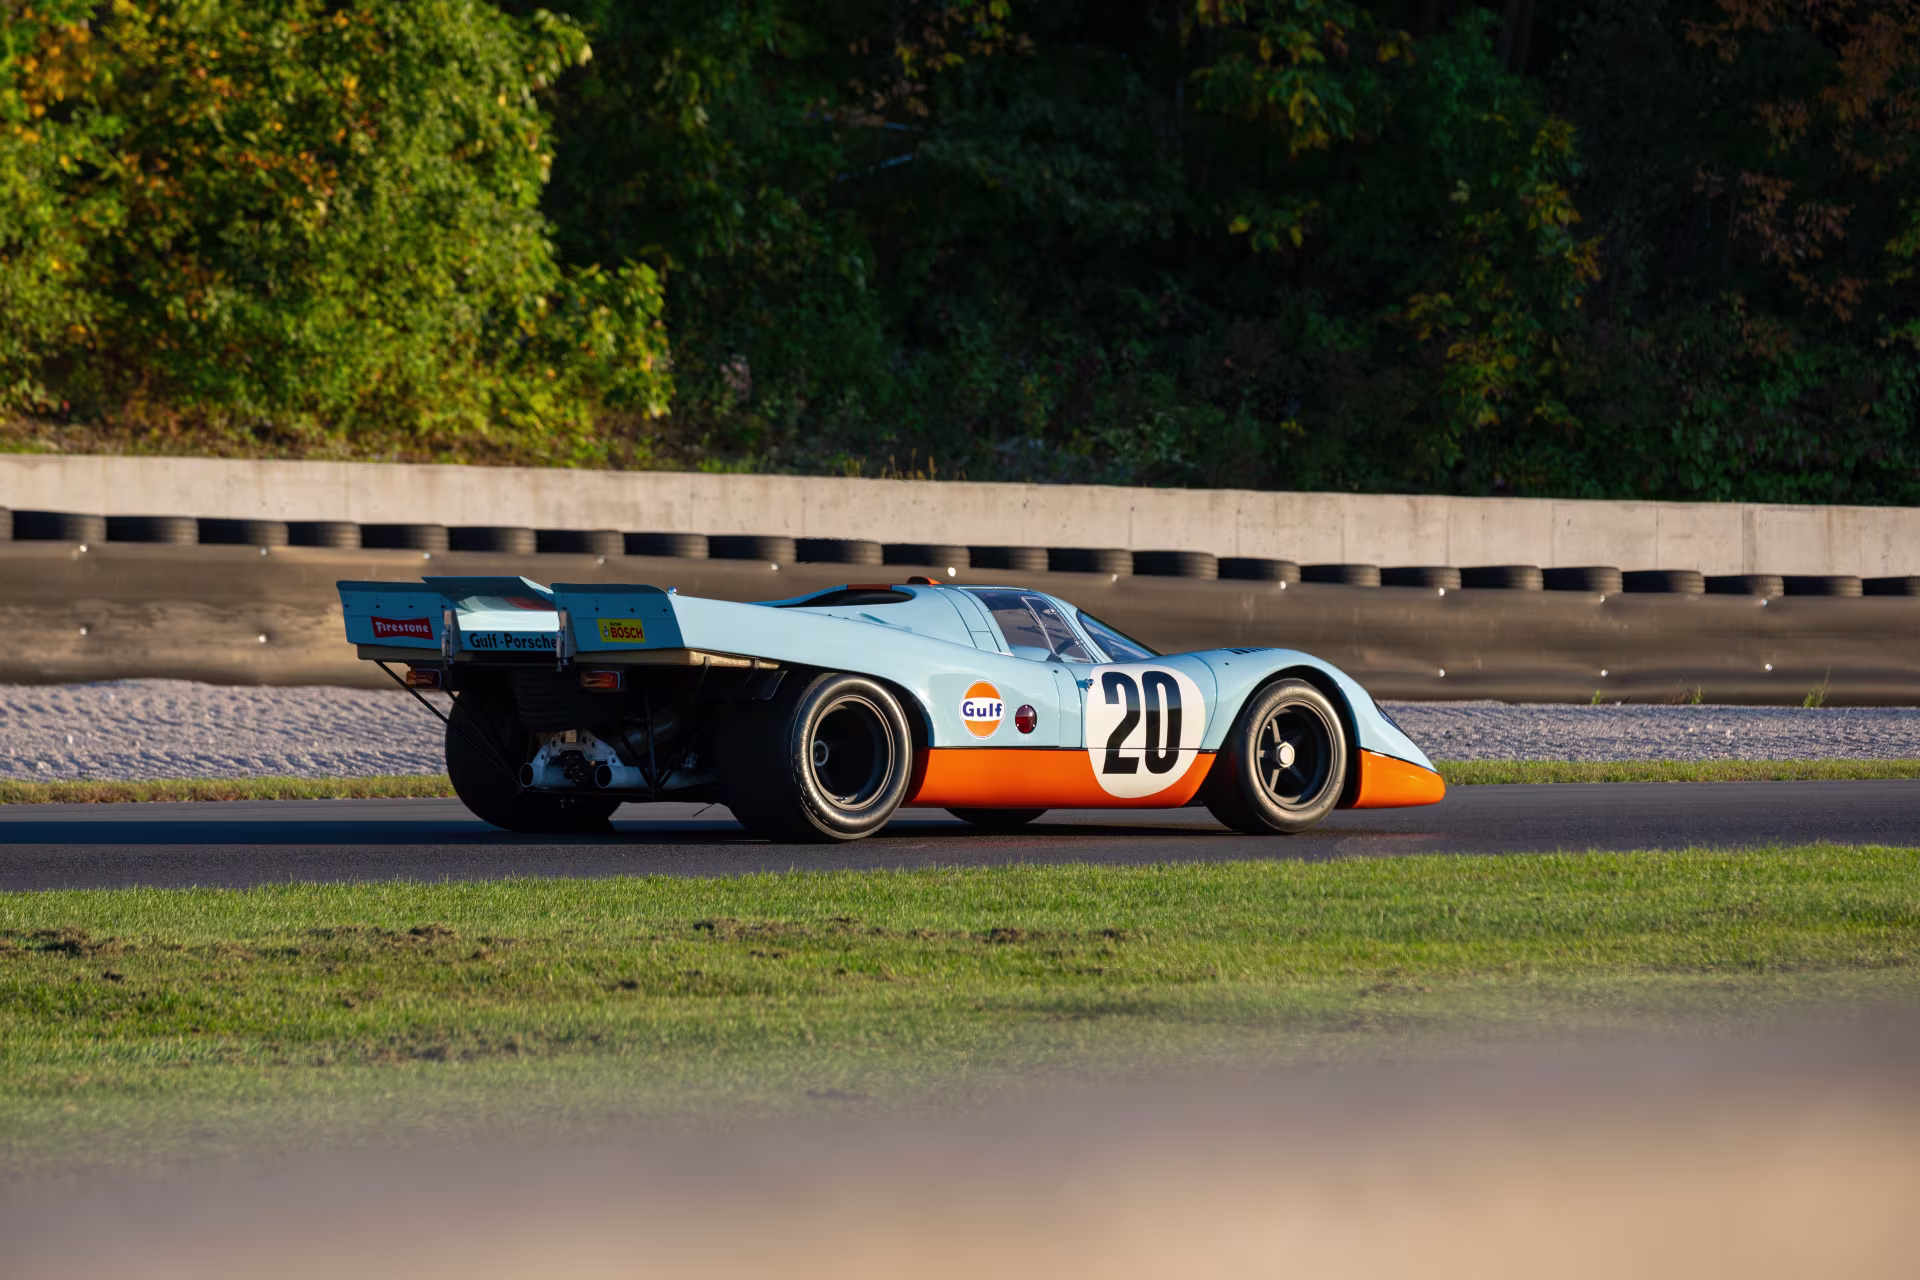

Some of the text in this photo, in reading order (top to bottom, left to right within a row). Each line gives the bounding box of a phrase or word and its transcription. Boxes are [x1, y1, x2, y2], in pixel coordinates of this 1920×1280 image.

[375, 621, 430, 633] Firestone
[610, 627, 643, 639] BOSCH
[962, 701, 1003, 717] Gulf
[1101, 670, 1183, 775] 20
